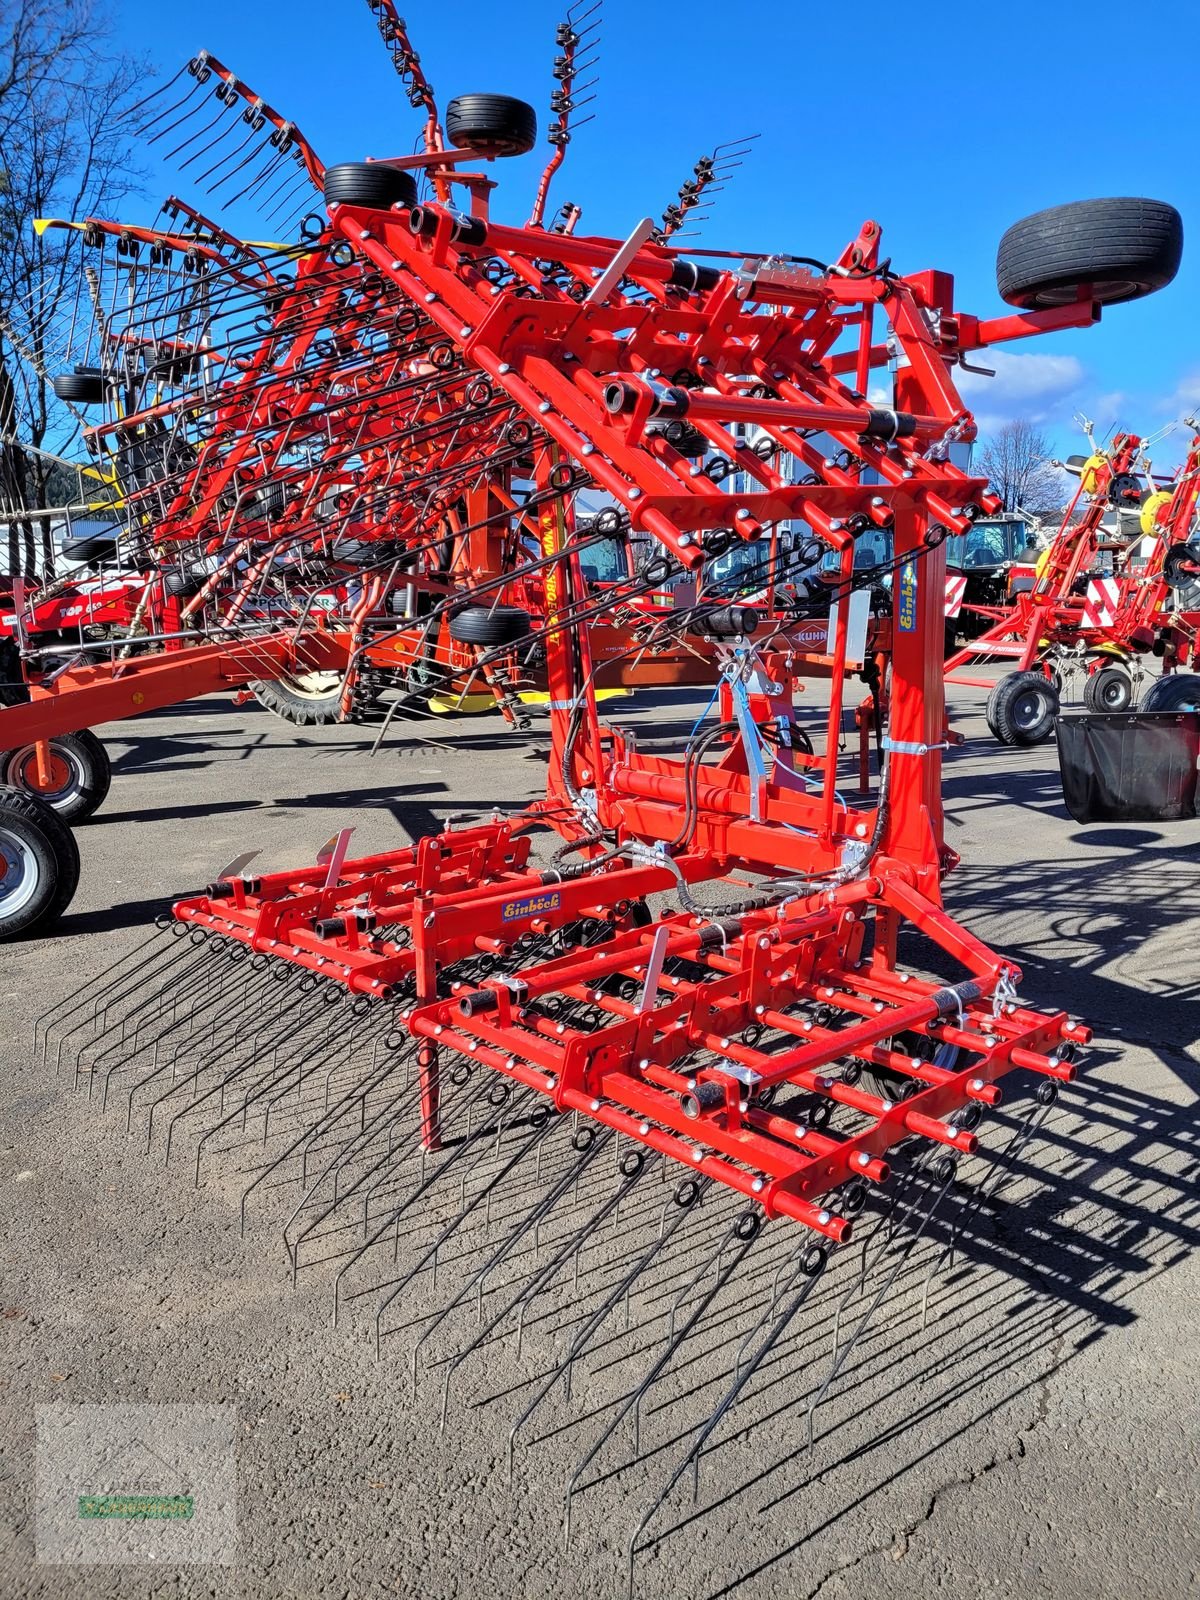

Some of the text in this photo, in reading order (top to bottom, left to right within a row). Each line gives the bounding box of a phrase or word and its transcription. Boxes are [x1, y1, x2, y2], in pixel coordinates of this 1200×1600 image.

[59, 605, 83, 618] TOP
[798, 631, 828, 641] KUHN
[504, 893, 559, 917] Einböck
